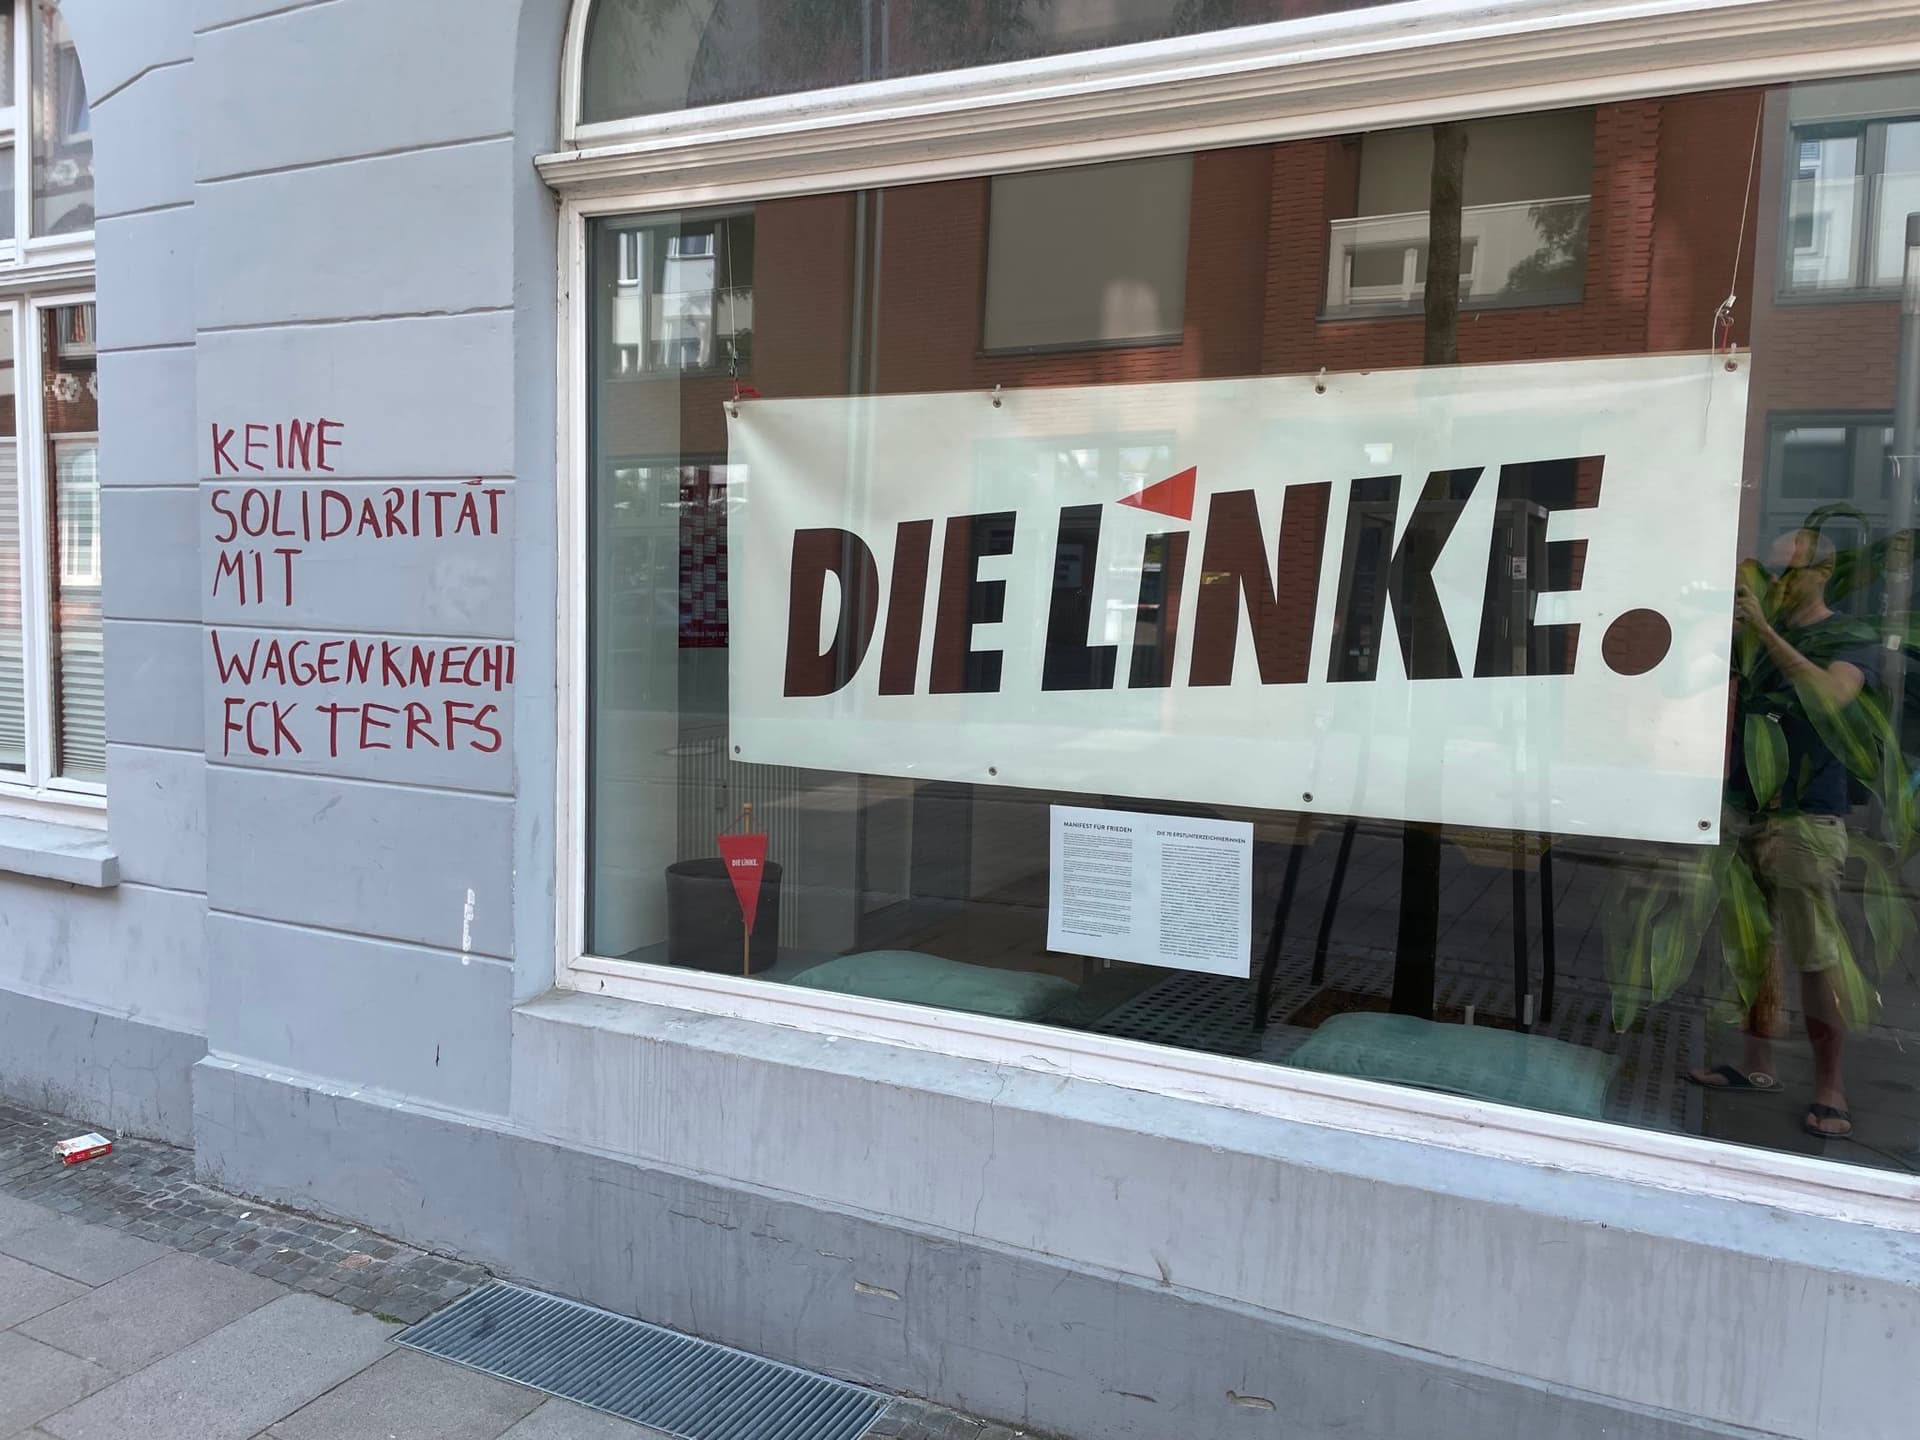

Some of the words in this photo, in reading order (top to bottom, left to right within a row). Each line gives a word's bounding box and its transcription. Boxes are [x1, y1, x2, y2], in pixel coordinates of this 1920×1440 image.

[212, 418, 344, 475] KEINE
[211, 477, 506, 543] SOLIDARITÄT
[213, 547, 303, 607] MIT
[783, 510, 1017, 698] DIE
[223, 697, 303, 757] FCK
[315, 700, 502, 757] TERFS
[1063, 821, 1093, 830] MANIFEST
[1093, 823, 1105, 831] FÜR
[1106, 825, 1133, 833] FRIEDEN
